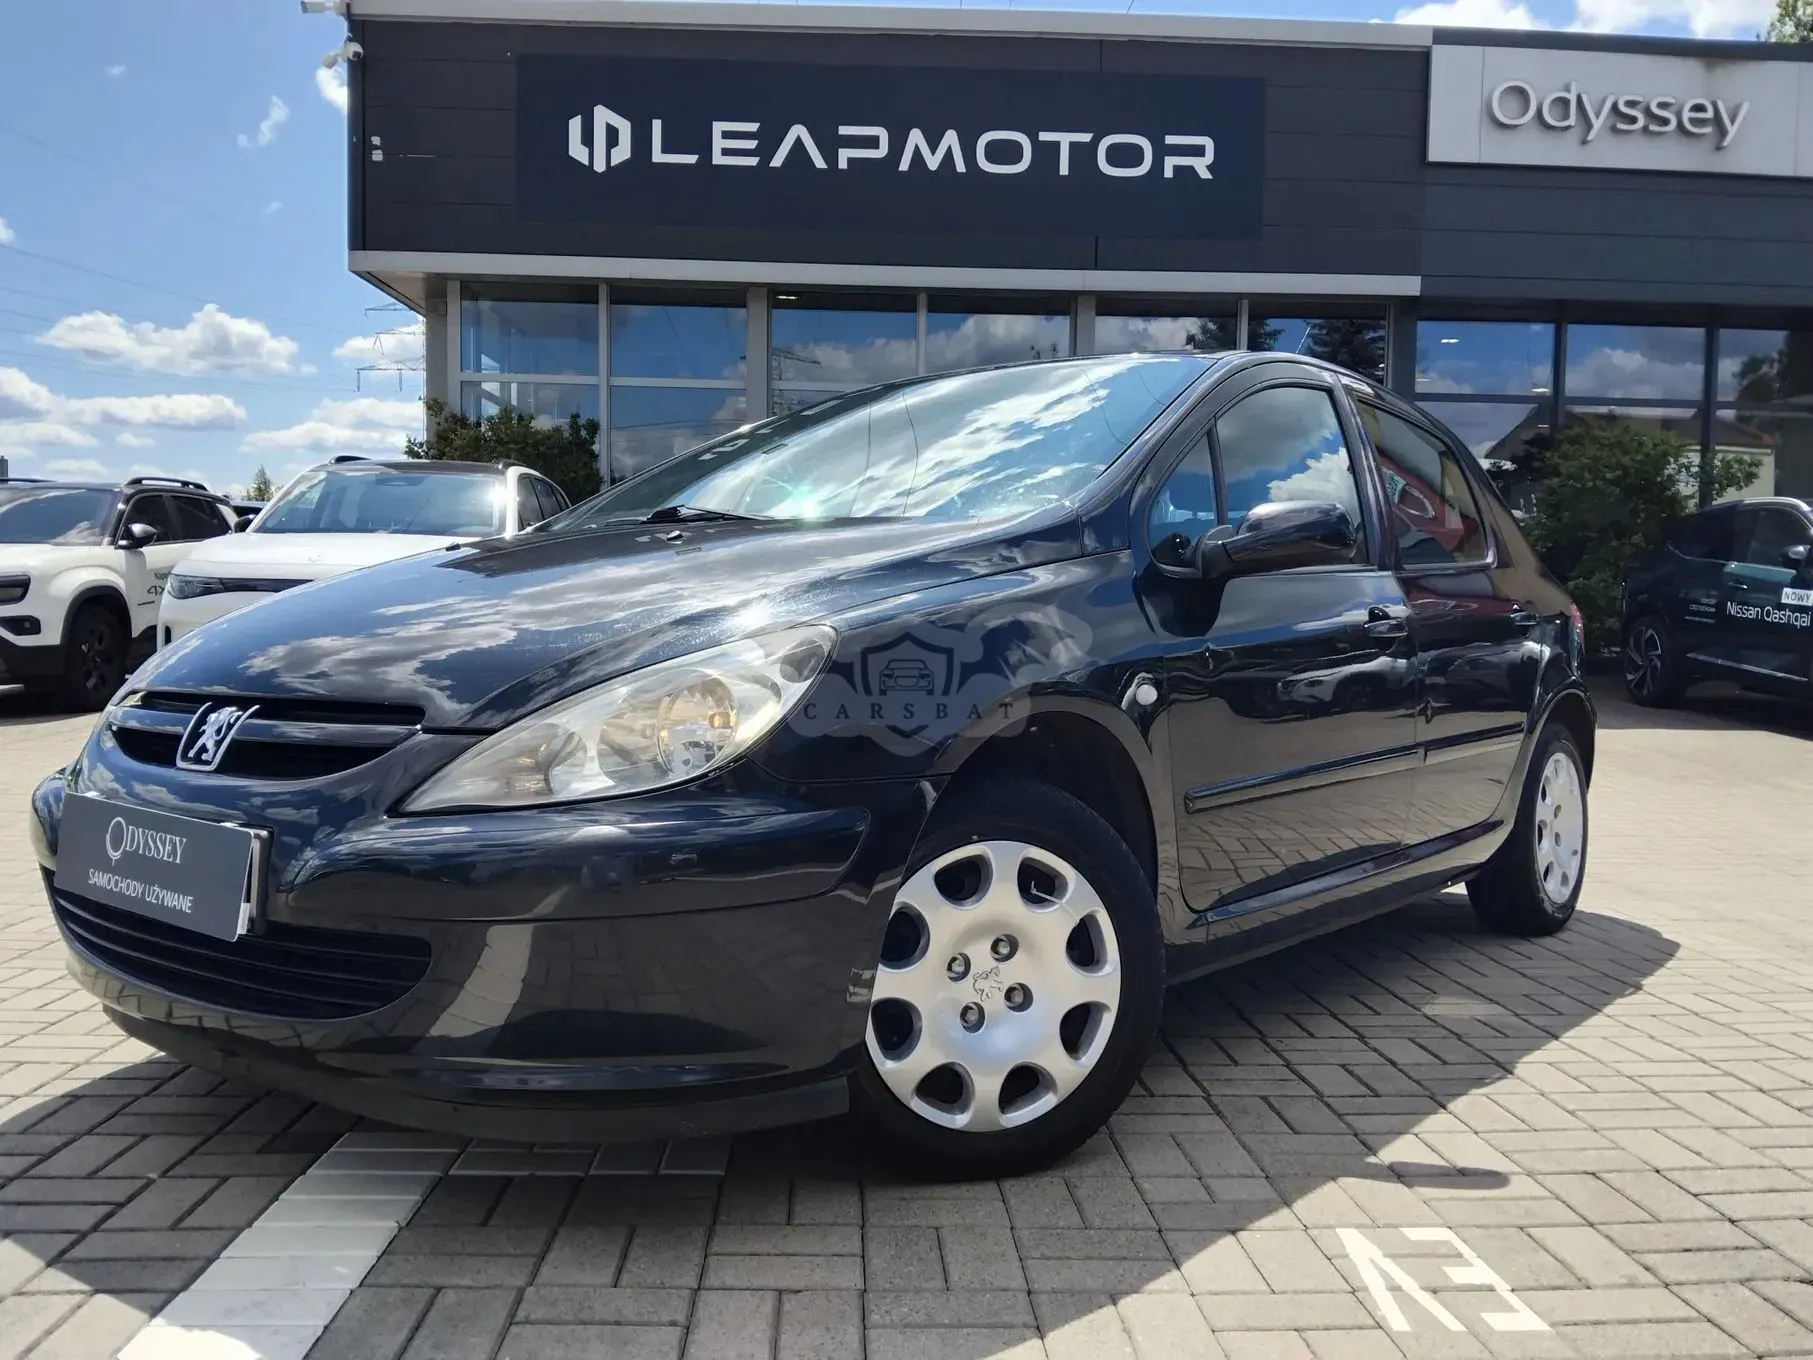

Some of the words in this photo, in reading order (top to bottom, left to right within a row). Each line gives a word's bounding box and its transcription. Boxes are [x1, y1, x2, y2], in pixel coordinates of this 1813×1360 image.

[1490, 79, 1751, 151] Odyssey
[651, 118, 1215, 179] LEAPMOTOR
[1726, 601, 1762, 620] Nissan
[1763, 605, 1812, 629] Qashqai
[1783, 590, 1812, 604] NOWY
[105, 816, 188, 866] ODYSSEY
[88, 868, 145, 897] SAMOCHODY
[145, 884, 194, 913] UŻYWANE
